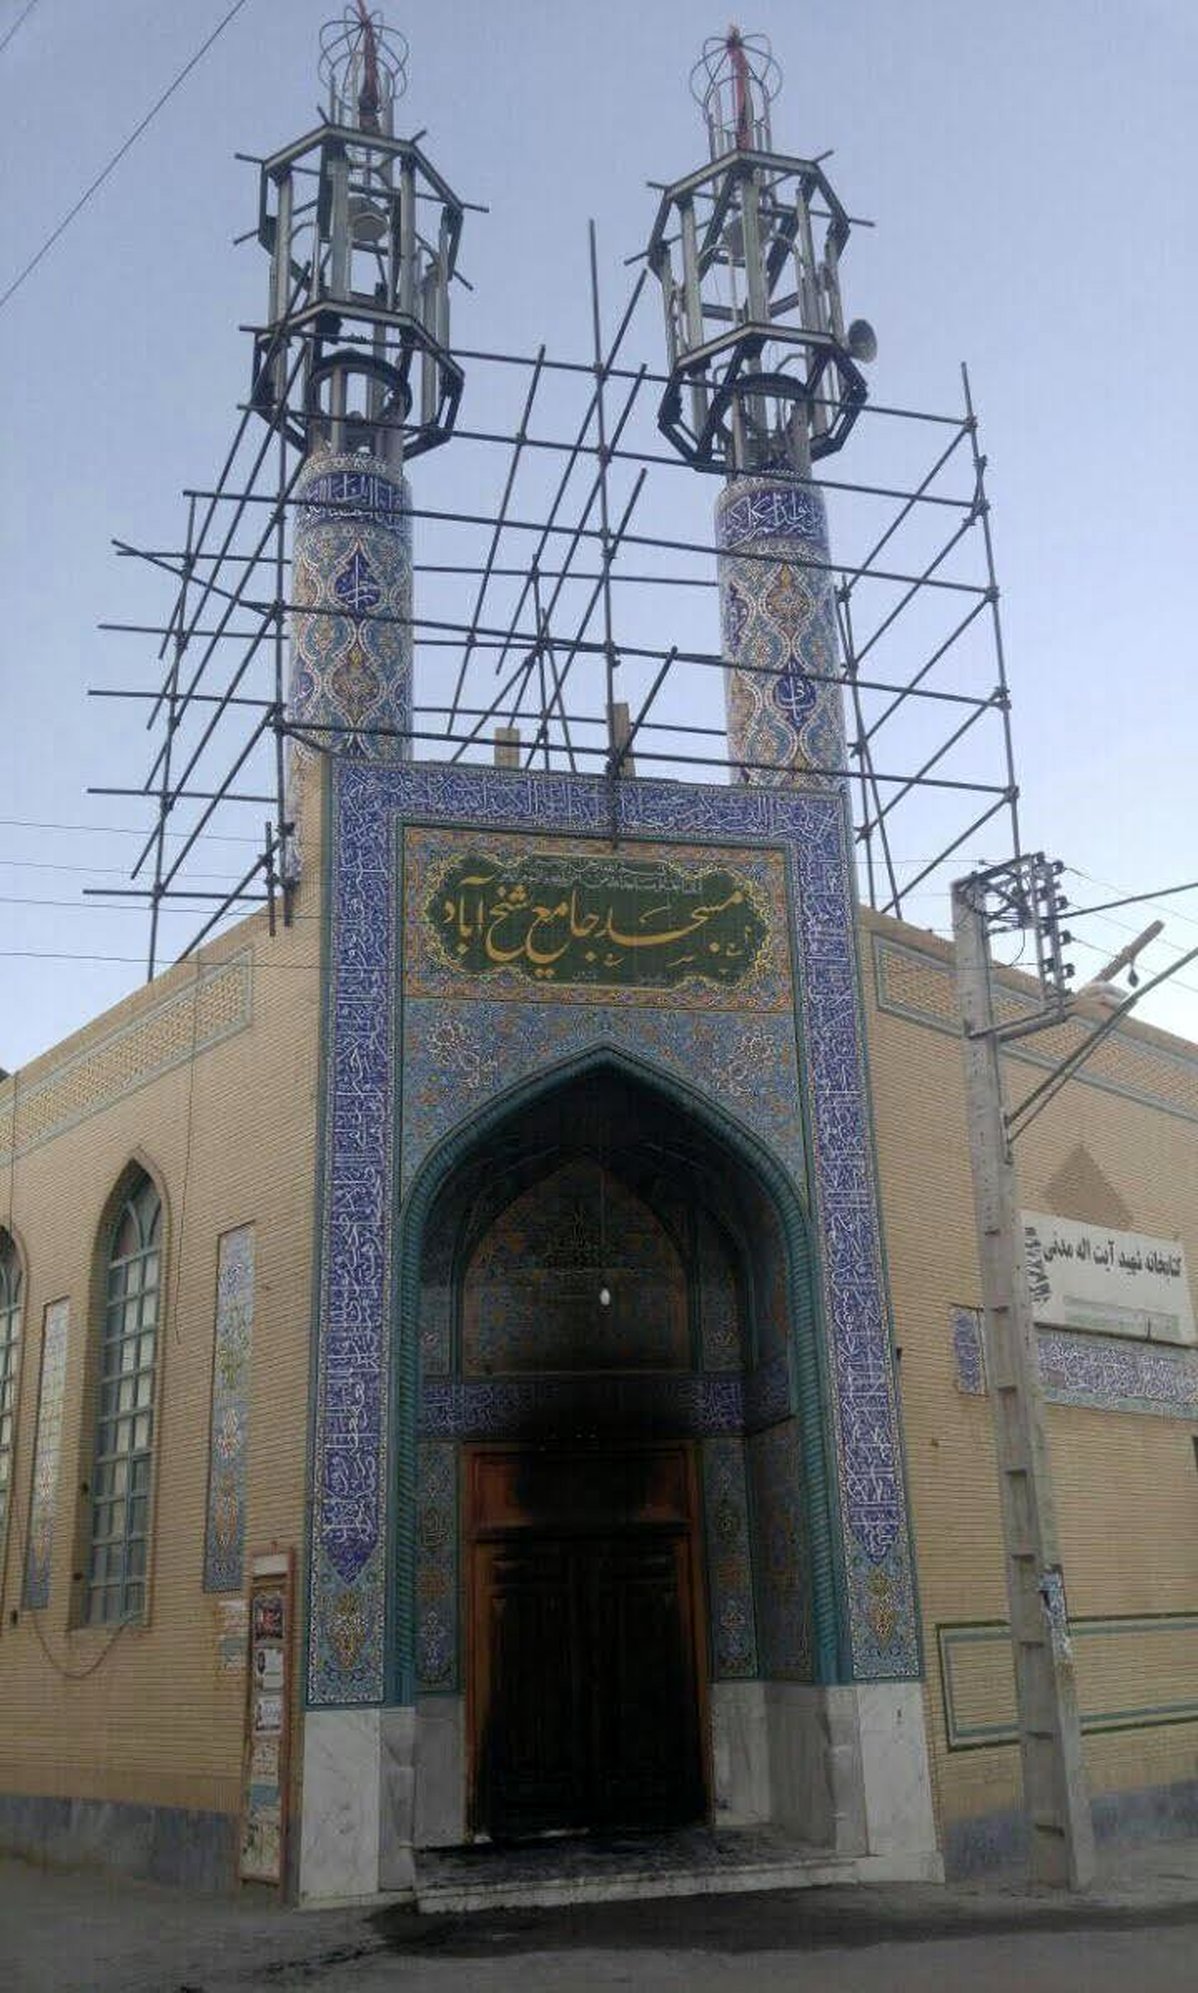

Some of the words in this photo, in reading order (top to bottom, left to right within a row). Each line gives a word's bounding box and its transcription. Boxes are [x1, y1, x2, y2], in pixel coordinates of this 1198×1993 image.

[444, 875, 495, 955] آباد
[526, 888, 600, 964] جامع
[594, 890, 744, 954] مسجد
[1094, 1239, 1115, 1272] آیت
[1119, 1250, 1142, 1275] شهید
[1145, 1251, 1182, 1282] کتابخانه
